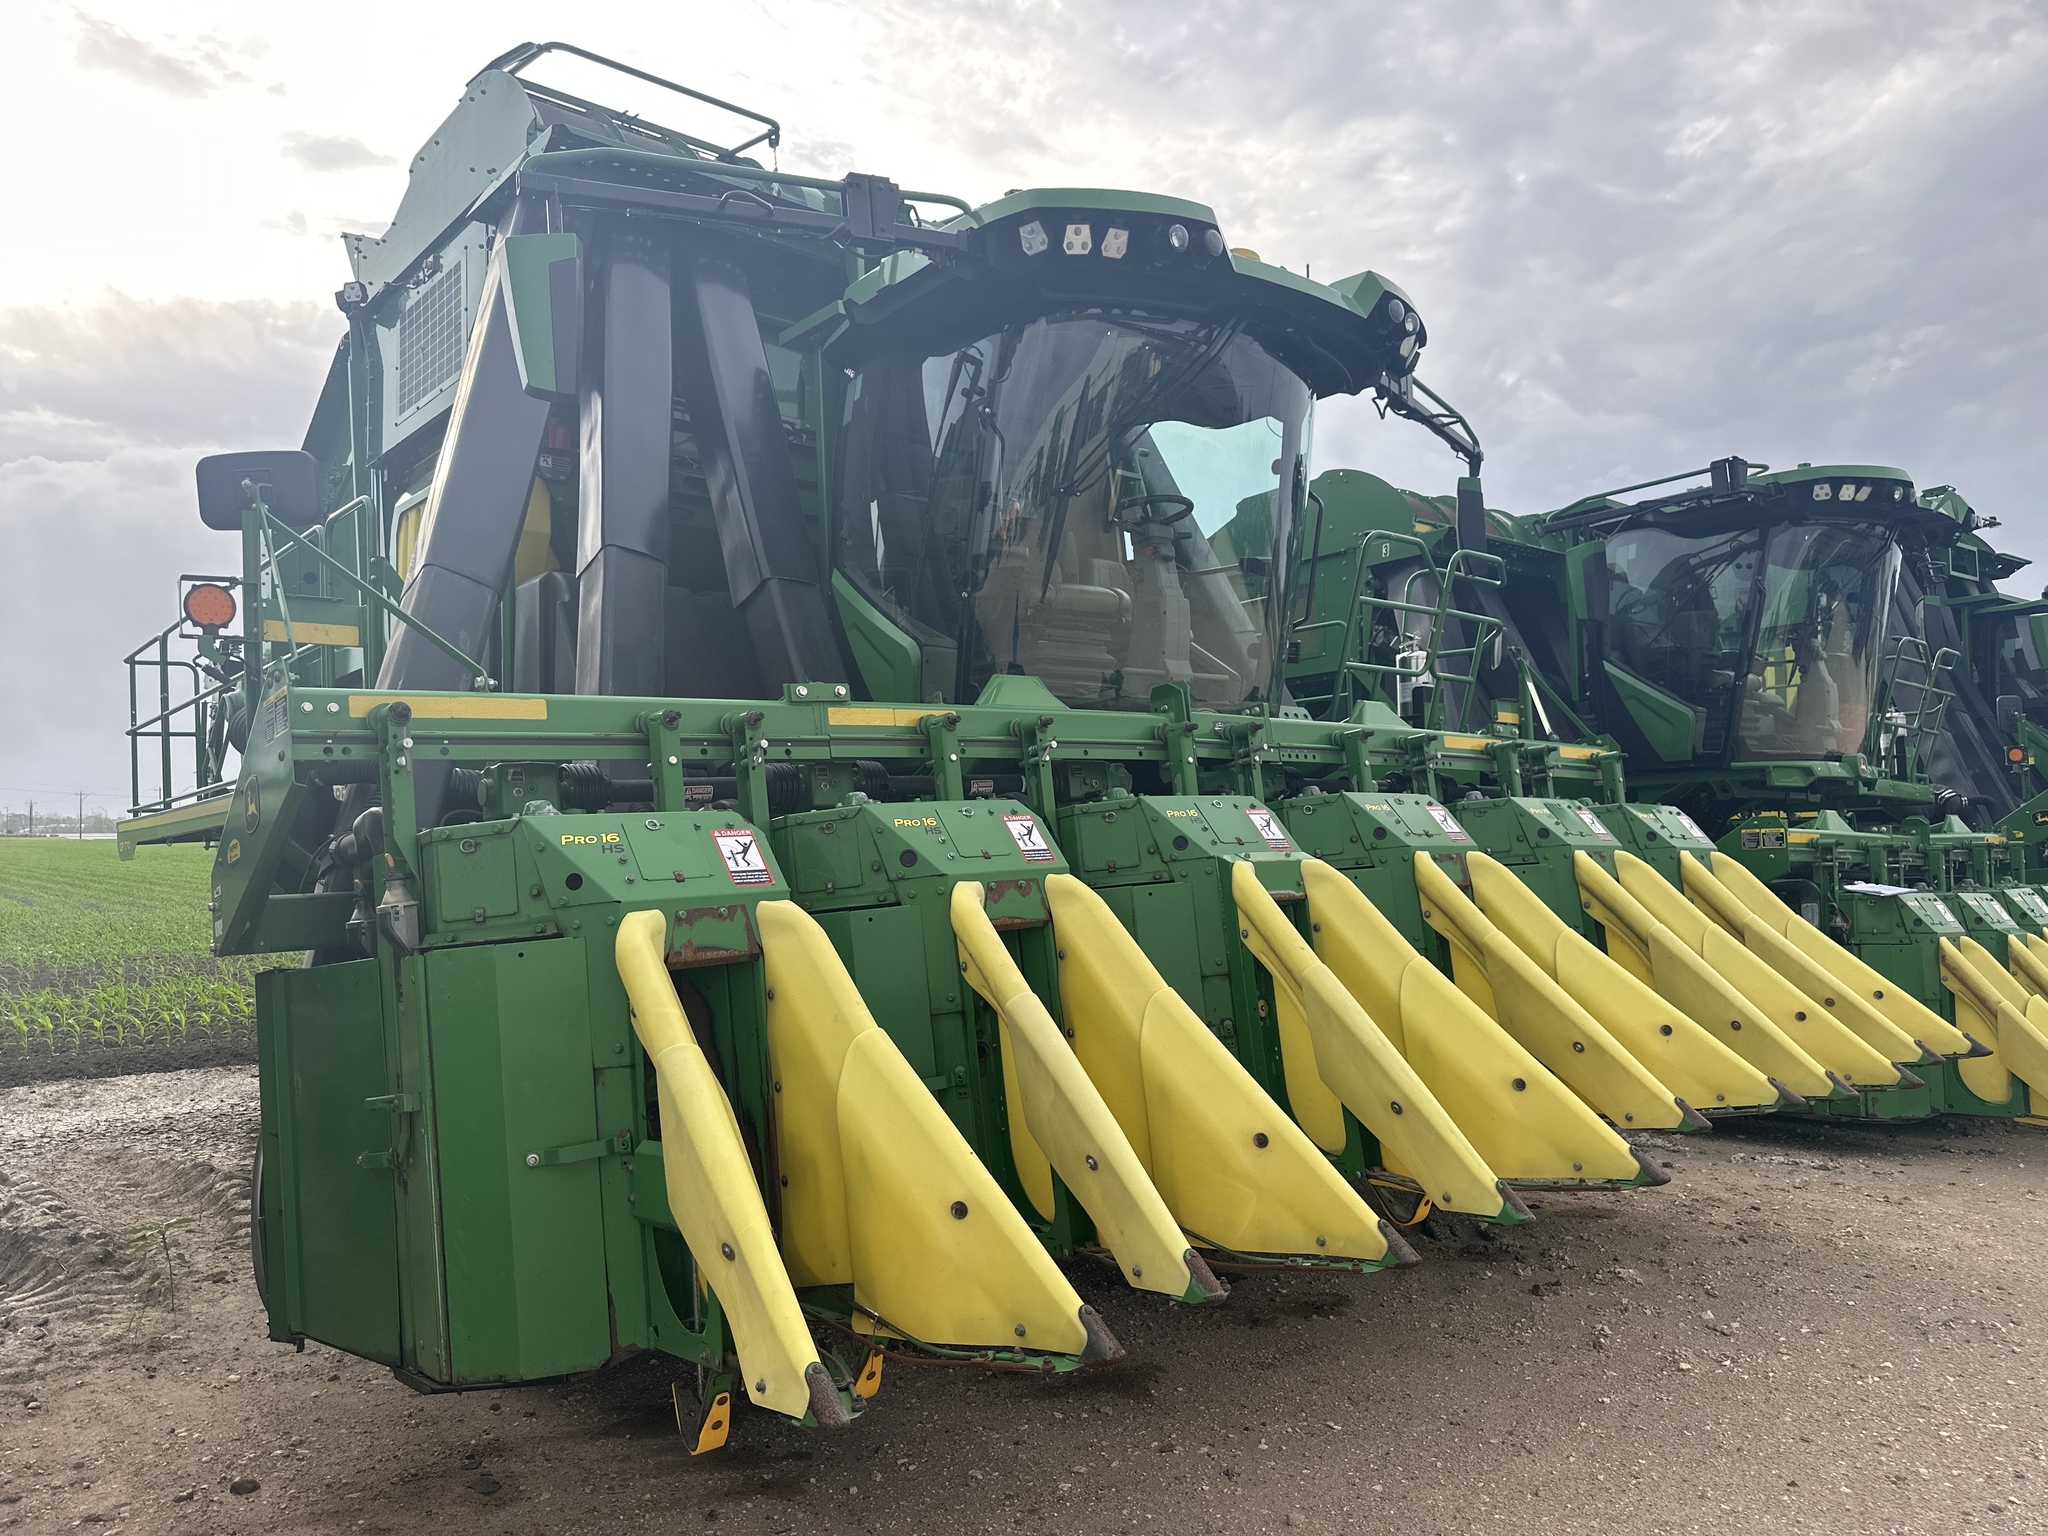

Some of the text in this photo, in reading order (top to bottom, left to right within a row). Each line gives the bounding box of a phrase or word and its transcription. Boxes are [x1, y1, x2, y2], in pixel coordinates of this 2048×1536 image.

[1166, 809, 1198, 818] PRO 16
[893, 817, 938, 828] PRO 16
[924, 826, 942, 835] HS
[561, 833, 620, 846] PRO 16
[601, 844, 625, 854] HS
